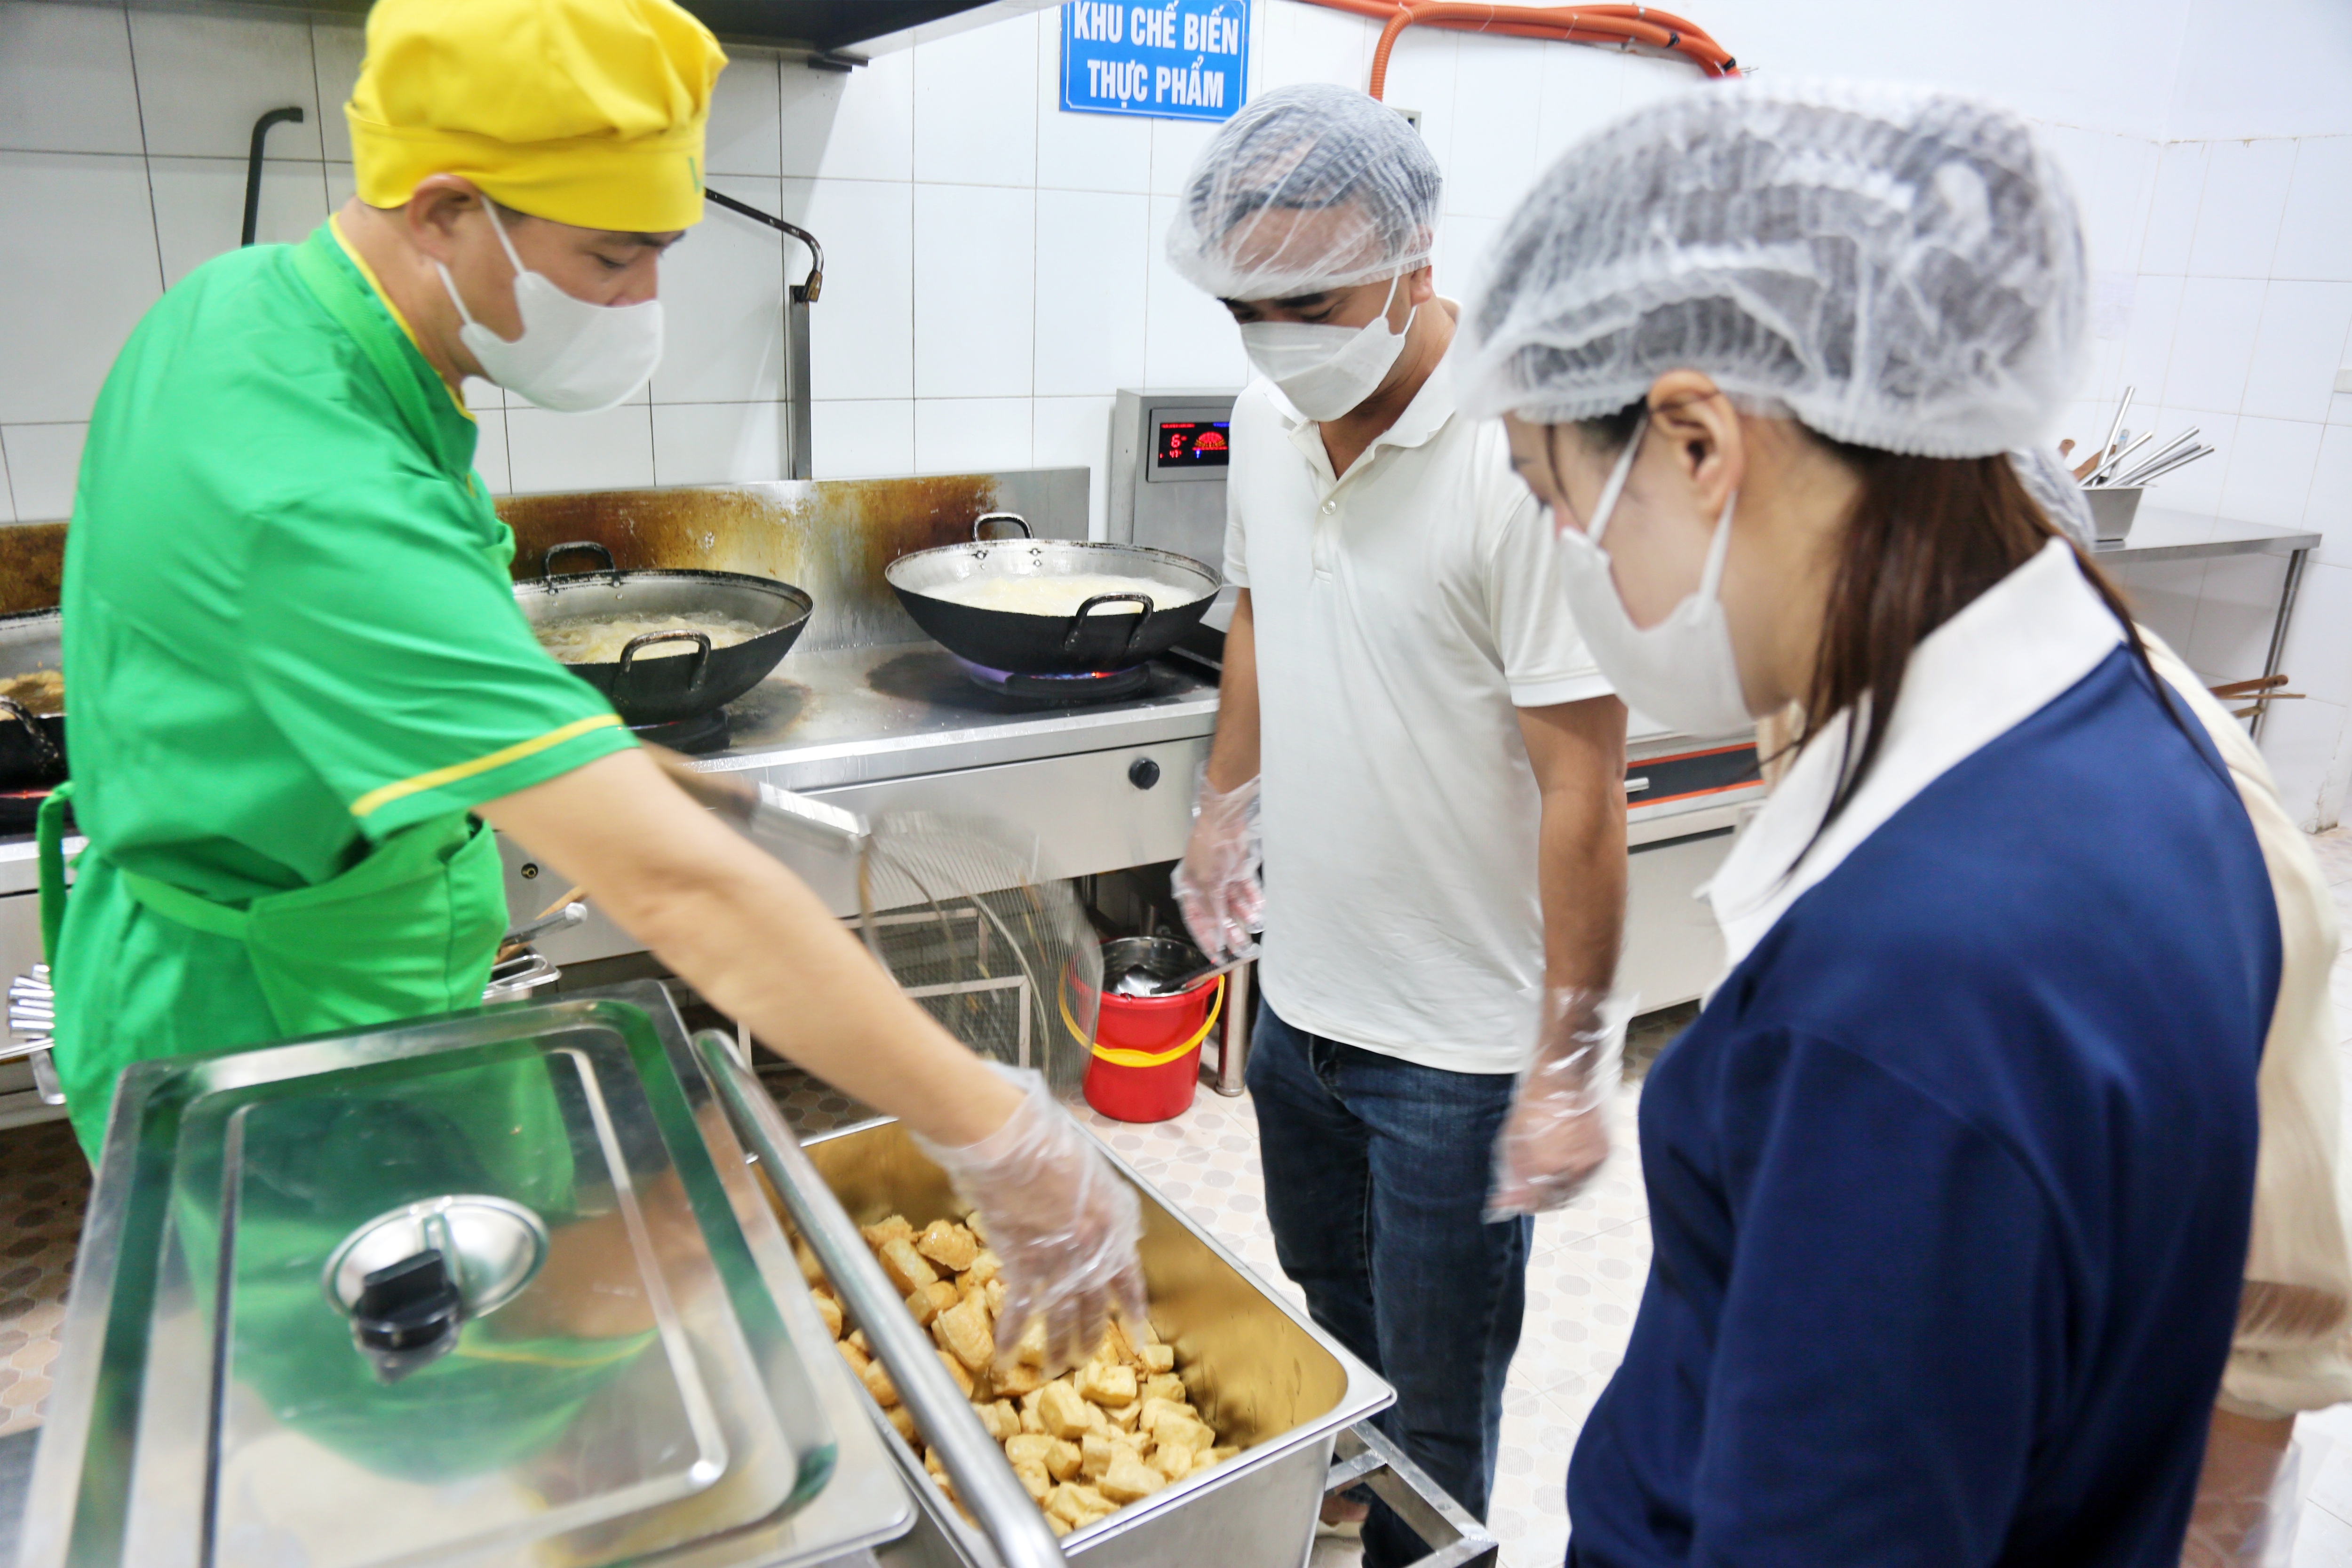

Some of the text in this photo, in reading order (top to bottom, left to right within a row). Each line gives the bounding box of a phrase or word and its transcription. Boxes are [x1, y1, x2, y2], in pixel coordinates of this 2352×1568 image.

[1074, 0, 1239, 56] KHU CHẾ BIẾN
[1087, 55, 1224, 109] THỰC PHẨM
